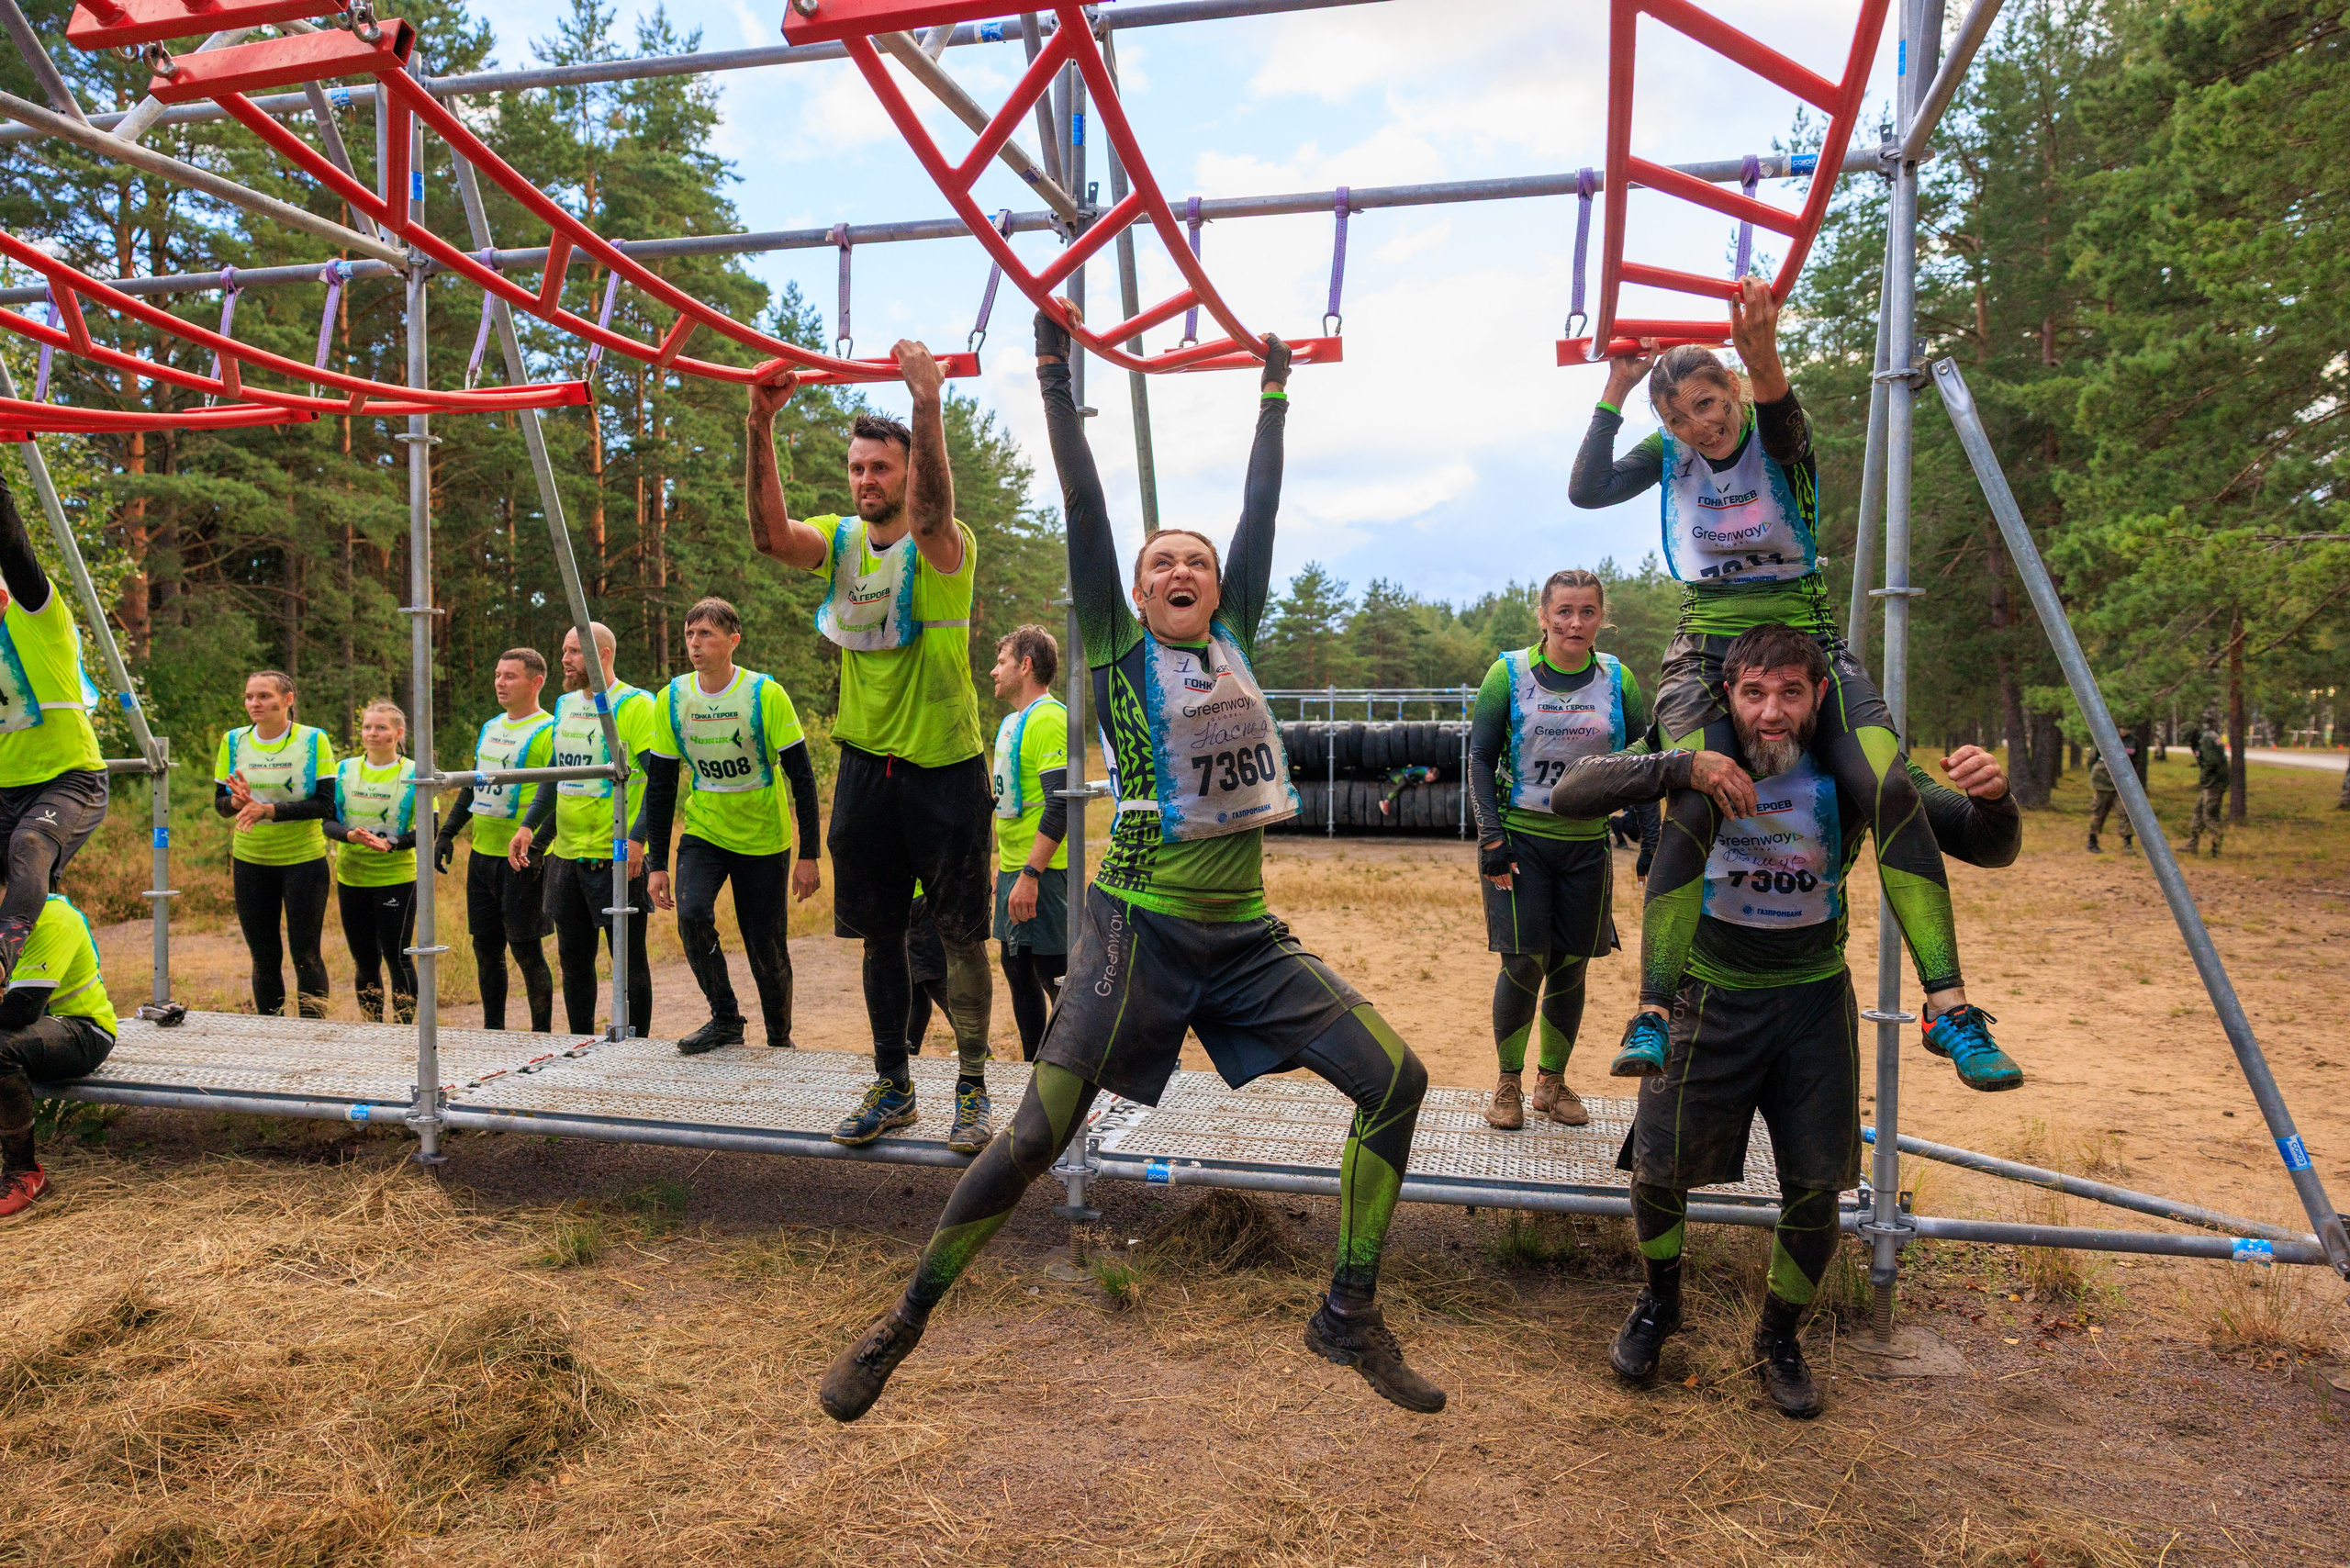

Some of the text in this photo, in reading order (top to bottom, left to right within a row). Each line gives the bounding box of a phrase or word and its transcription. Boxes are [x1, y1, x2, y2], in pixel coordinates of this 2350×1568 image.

[1724, 489, 1758, 506] ГЕРОЕВ
[1692, 523, 1762, 542] Greenway
[859, 587, 890, 601] ГЕРОЕВ
[1184, 678, 1214, 690] ГОНК
[1182, 697, 1251, 718] Greenway
[1535, 725, 1593, 736] Greenway
[690, 734, 730, 745] Чижик
[698, 756, 752, 779] 6908
[1192, 742, 1277, 797] 7360
[1534, 760, 1566, 786] 73
[1232, 803, 1271, 819] ГАЗПРОМБАНК
[1755, 799, 1793, 812] ЕРОЕВ
[1717, 832, 1792, 846] Greenway
[1757, 908, 1802, 918] ГАЗПРОМБАНК
[1094, 909, 1124, 997] Greenway
